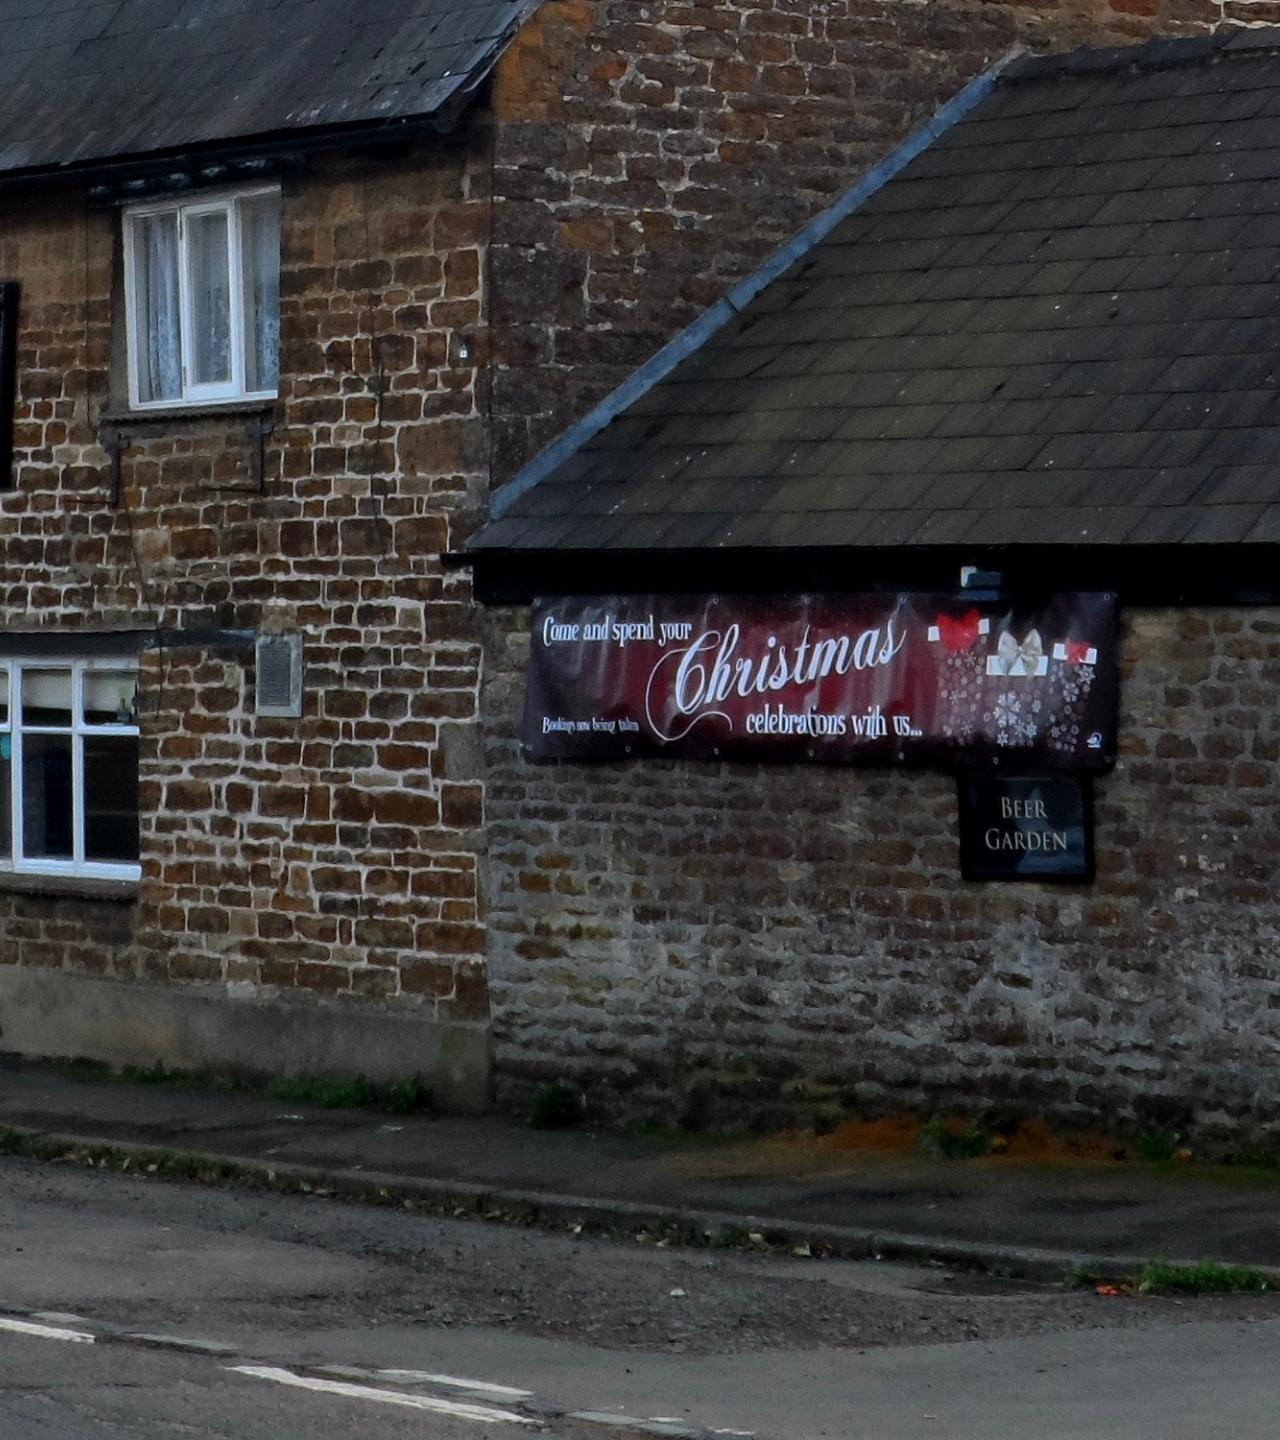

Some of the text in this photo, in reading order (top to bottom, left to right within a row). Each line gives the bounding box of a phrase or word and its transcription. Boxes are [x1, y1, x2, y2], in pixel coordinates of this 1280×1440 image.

[543, 613, 693, 648] Come and spend your
[645, 619, 907, 741] Christmas
[746, 704, 847, 738] celebrations
[850, 705, 888, 739] with
[1000, 795, 1048, 819] BEER
[984, 827, 1068, 852] GARDEN
